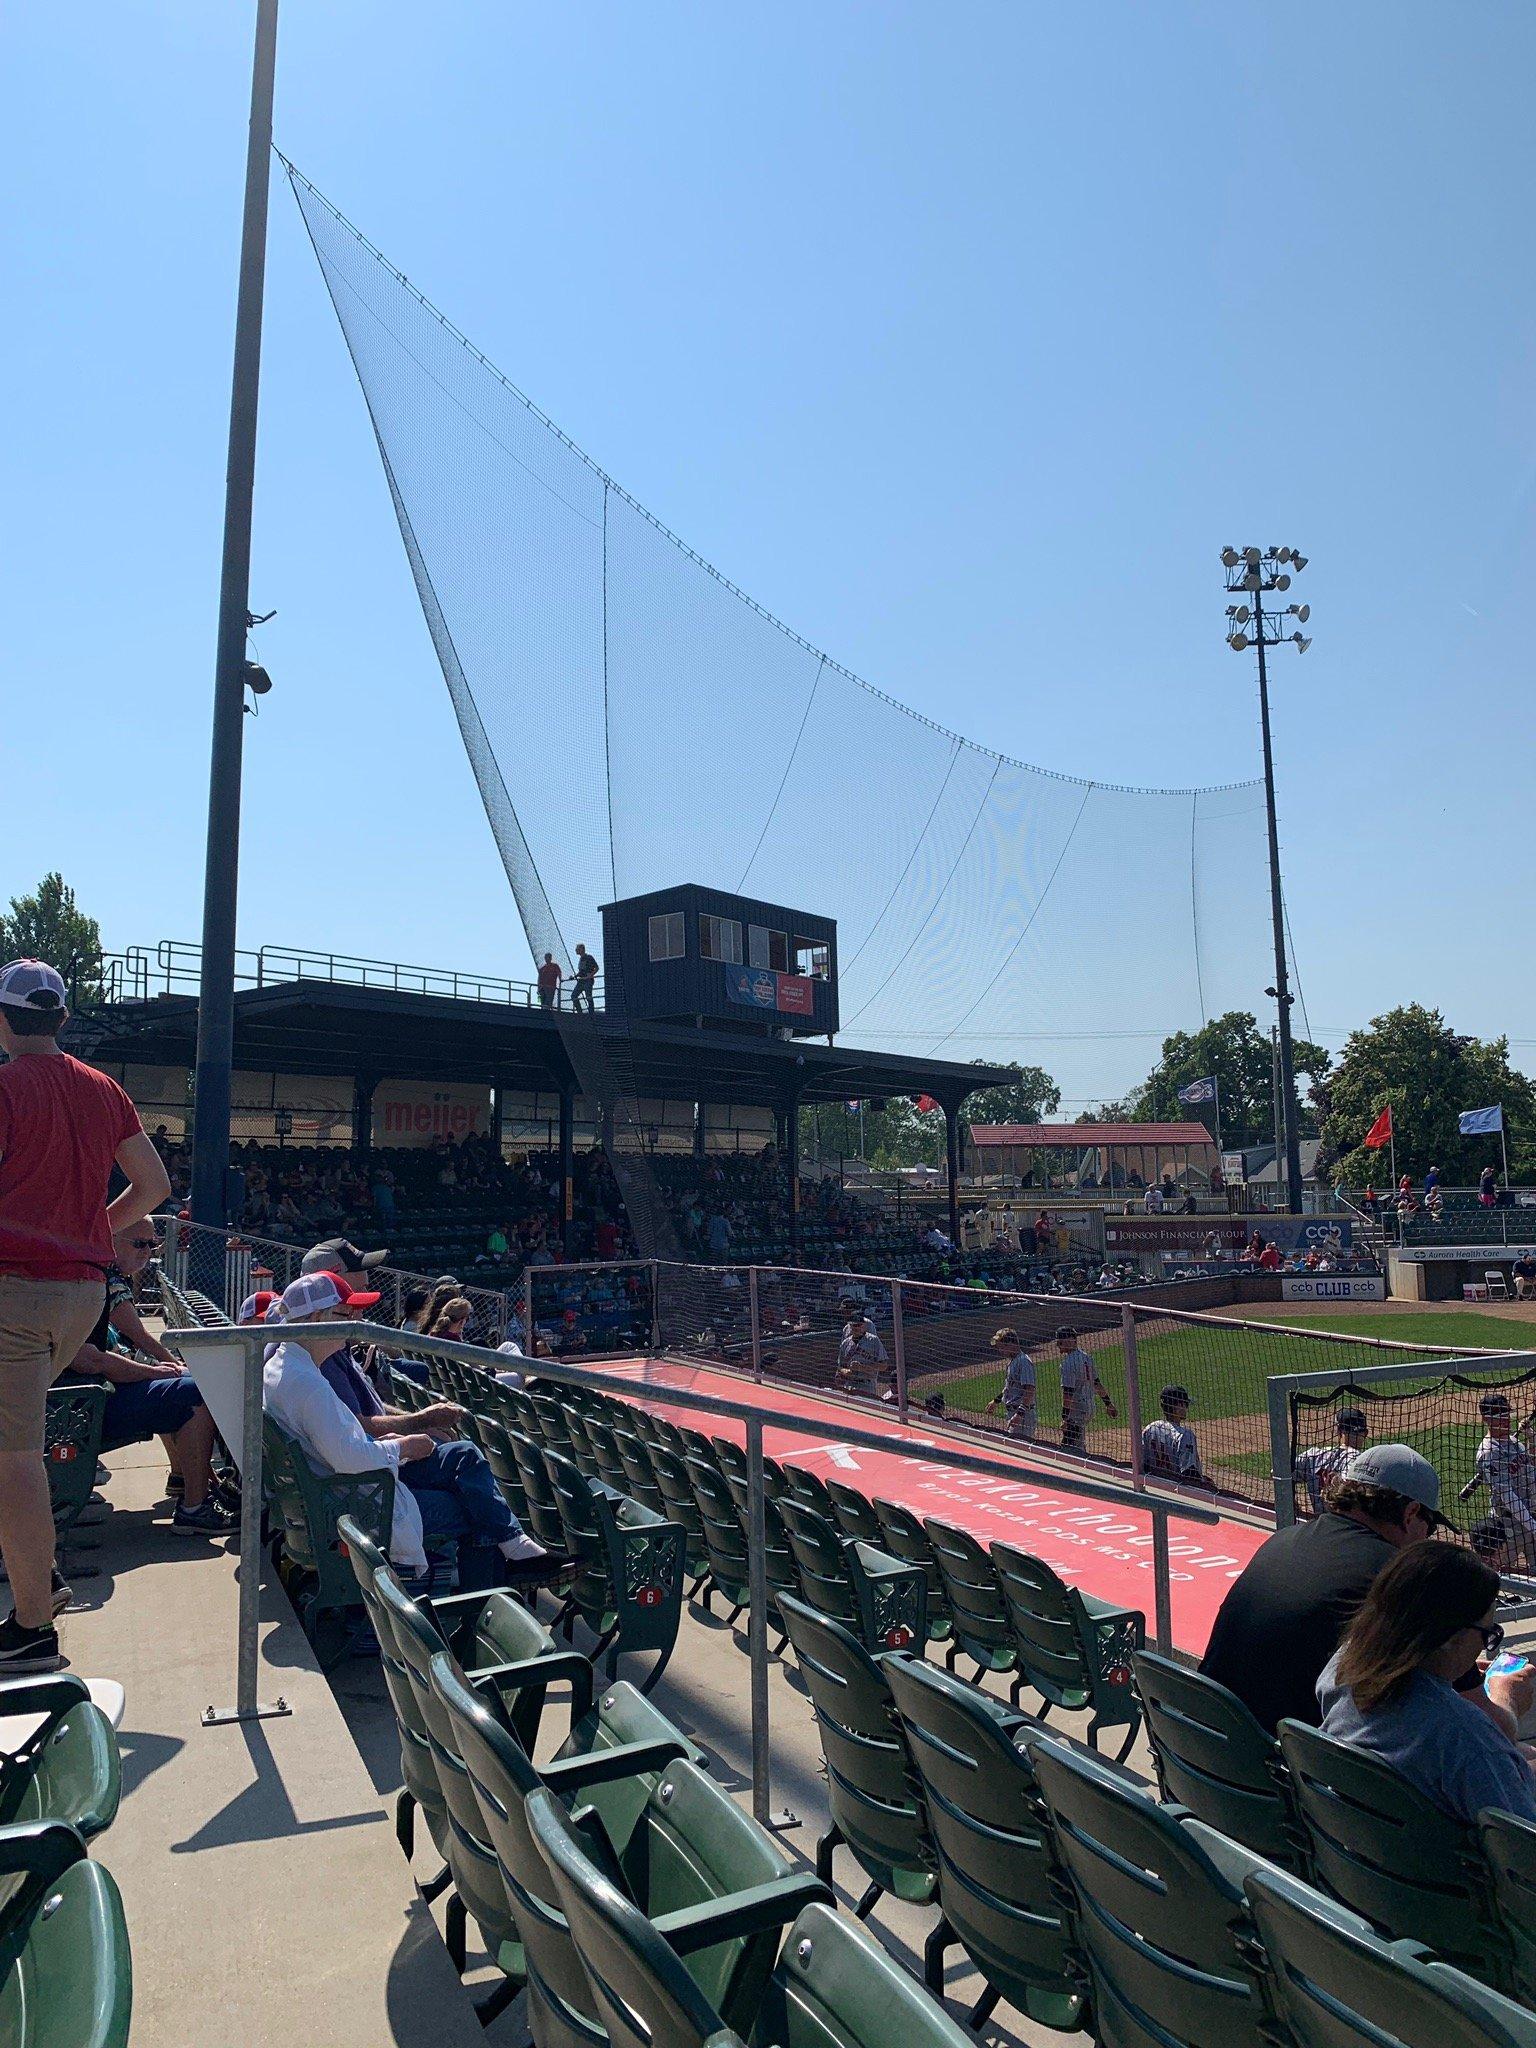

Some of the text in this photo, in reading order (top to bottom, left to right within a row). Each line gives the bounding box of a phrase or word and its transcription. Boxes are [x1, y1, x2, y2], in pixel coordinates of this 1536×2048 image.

[385, 1093, 481, 1144] meijer
[1456, 1250, 1480, 1258] Health
[1291, 1280, 1376, 1295] ccb CLUB ccb
[1038, 1526, 1095, 1545] DDS
[1092, 1545, 1140, 1560] MS
[646, 1591, 654, 1604] 6
[894, 1633, 901, 1645] 5
[1116, 1671, 1123, 1683] 4
